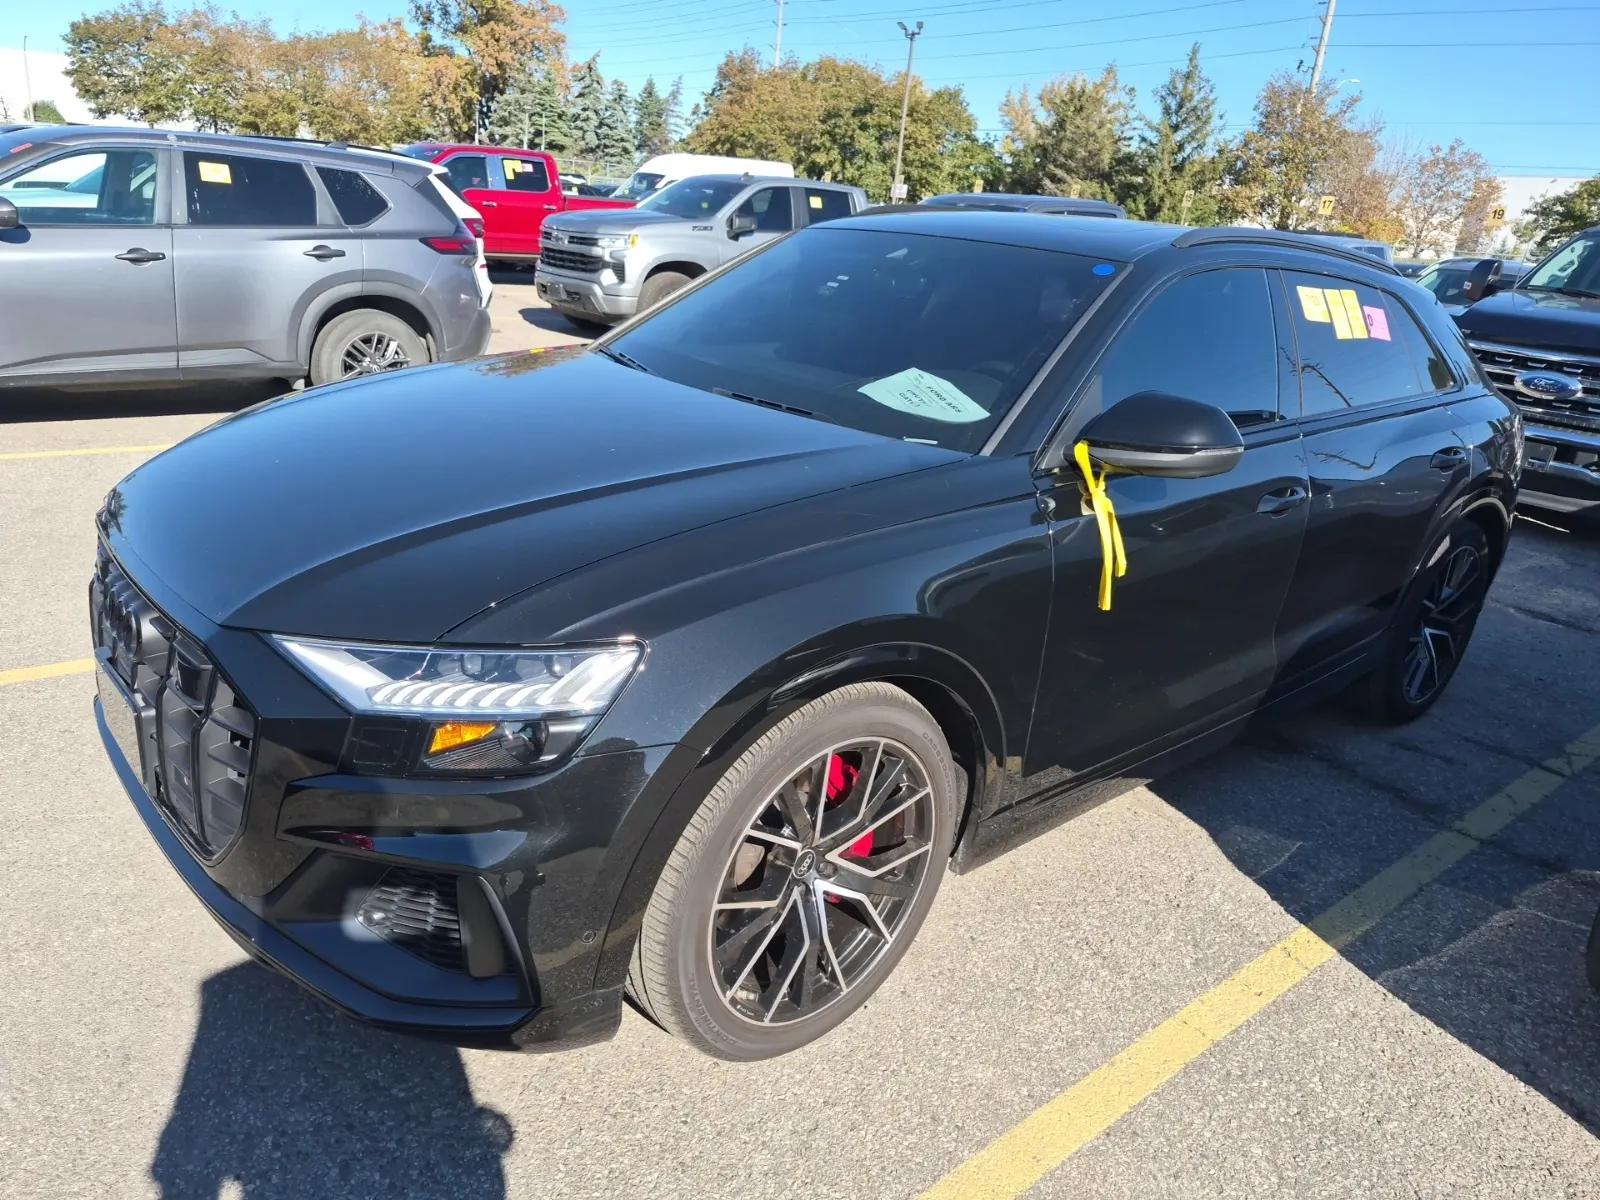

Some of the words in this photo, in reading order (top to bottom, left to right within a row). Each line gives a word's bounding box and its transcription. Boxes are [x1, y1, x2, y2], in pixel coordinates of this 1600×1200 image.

[1322, 200, 1333, 209] 17
[1492, 209, 1505, 219] 19
[1530, 378, 1557, 392] Ford
[926, 386, 946, 401] FORD
[945, 402, 963, 413] ARS
[691, 972, 737, 1046] CONTINENTAL
